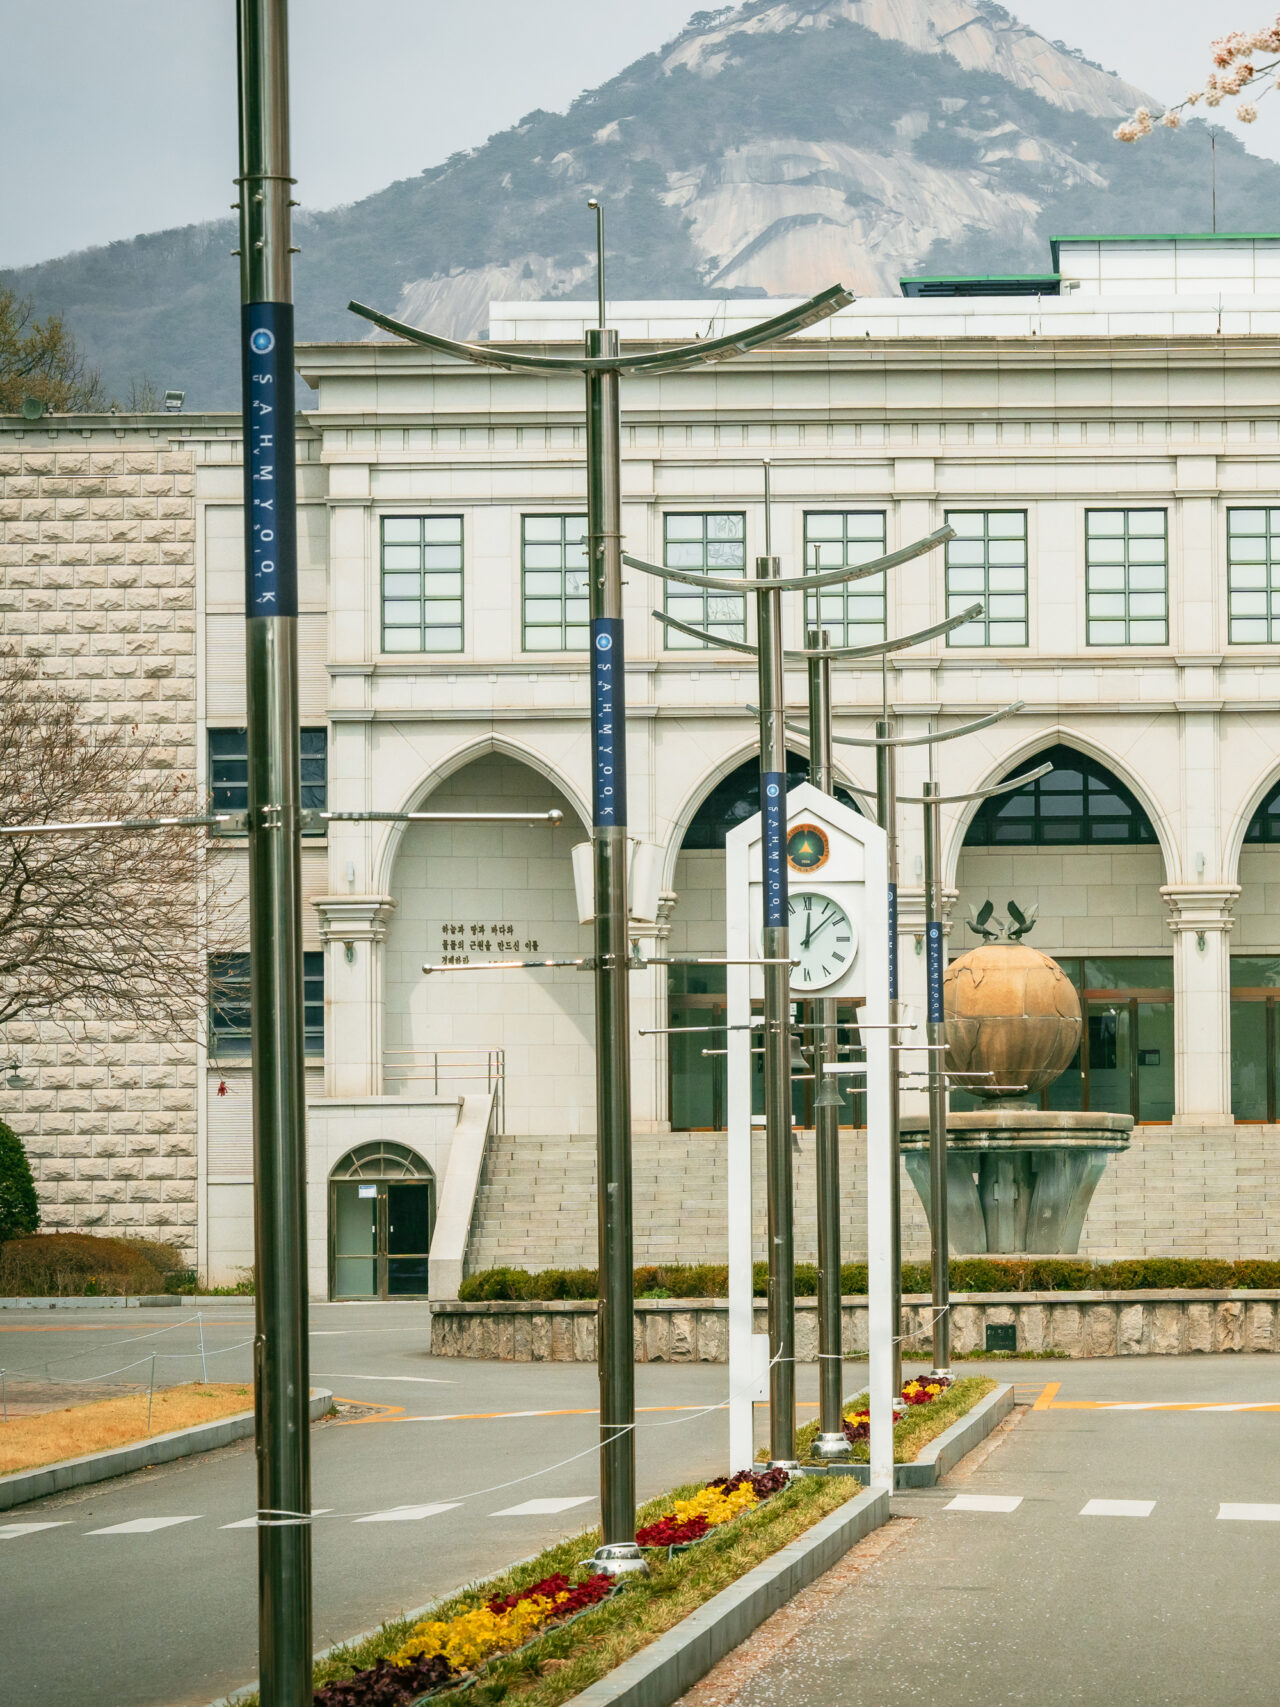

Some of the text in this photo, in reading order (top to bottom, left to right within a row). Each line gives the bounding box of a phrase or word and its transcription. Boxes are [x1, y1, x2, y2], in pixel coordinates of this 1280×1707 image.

[252, 374, 263, 604] UNIVERSITY
[259, 374, 276, 603] SAHMYOOK
[602, 663, 613, 815] SAHMYOOK
[771, 806, 780, 919] SAHMYOOK
[441, 923, 514, 936] 하늘과 땅과 바다와
[469, 940, 492, 952] 근원을
[497, 940, 520, 952] 만드신
[524, 940, 539, 952] 이를
